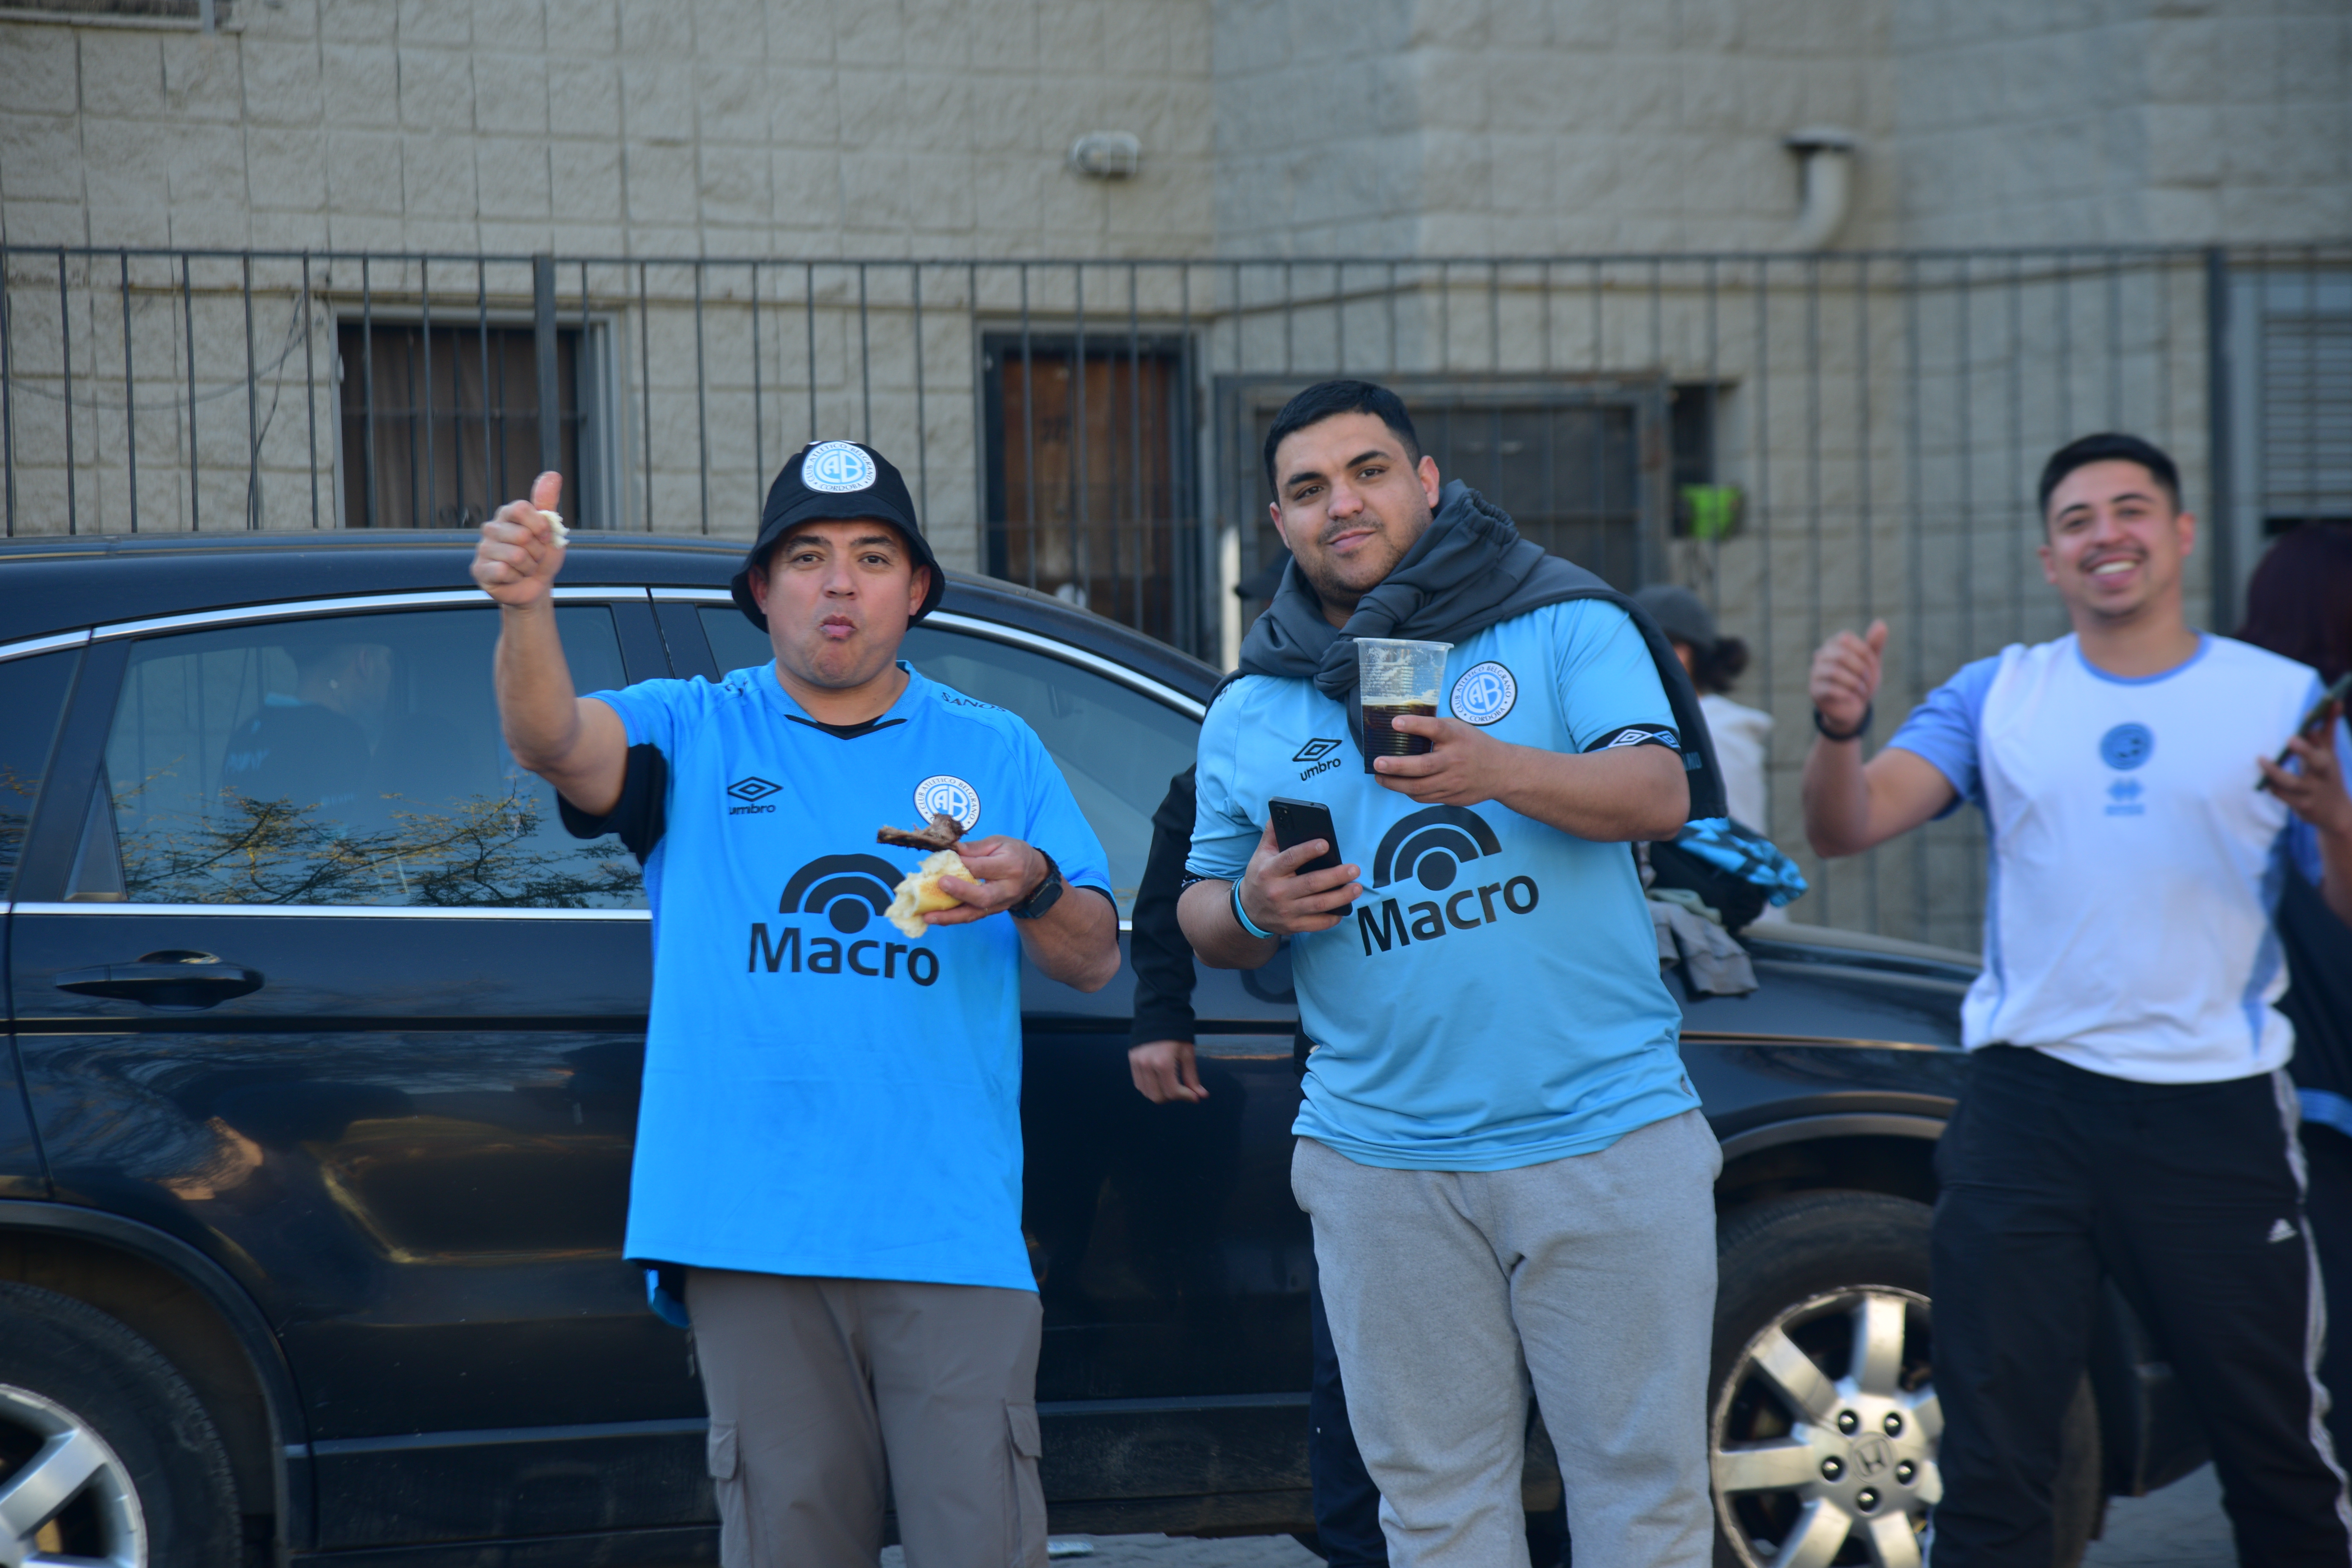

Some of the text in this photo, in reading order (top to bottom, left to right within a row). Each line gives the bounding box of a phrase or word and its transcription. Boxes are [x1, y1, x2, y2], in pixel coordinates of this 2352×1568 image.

[805, 443, 873, 482] CLUB ATLETICO BELGRANO
[820, 482, 864, 491] CORDOBA
[1455, 665, 1512, 713] CLUB ATLETICO BELGRANO
[1469, 707, 1506, 722] CORDOBA
[1300, 758, 1341, 781] umbro
[729, 803, 777, 815] umbro
[918, 777, 977, 820] CLUB ATLETICO BELGRANO
[1357, 875, 1539, 957] Macro
[748, 922, 940, 986] Macro
